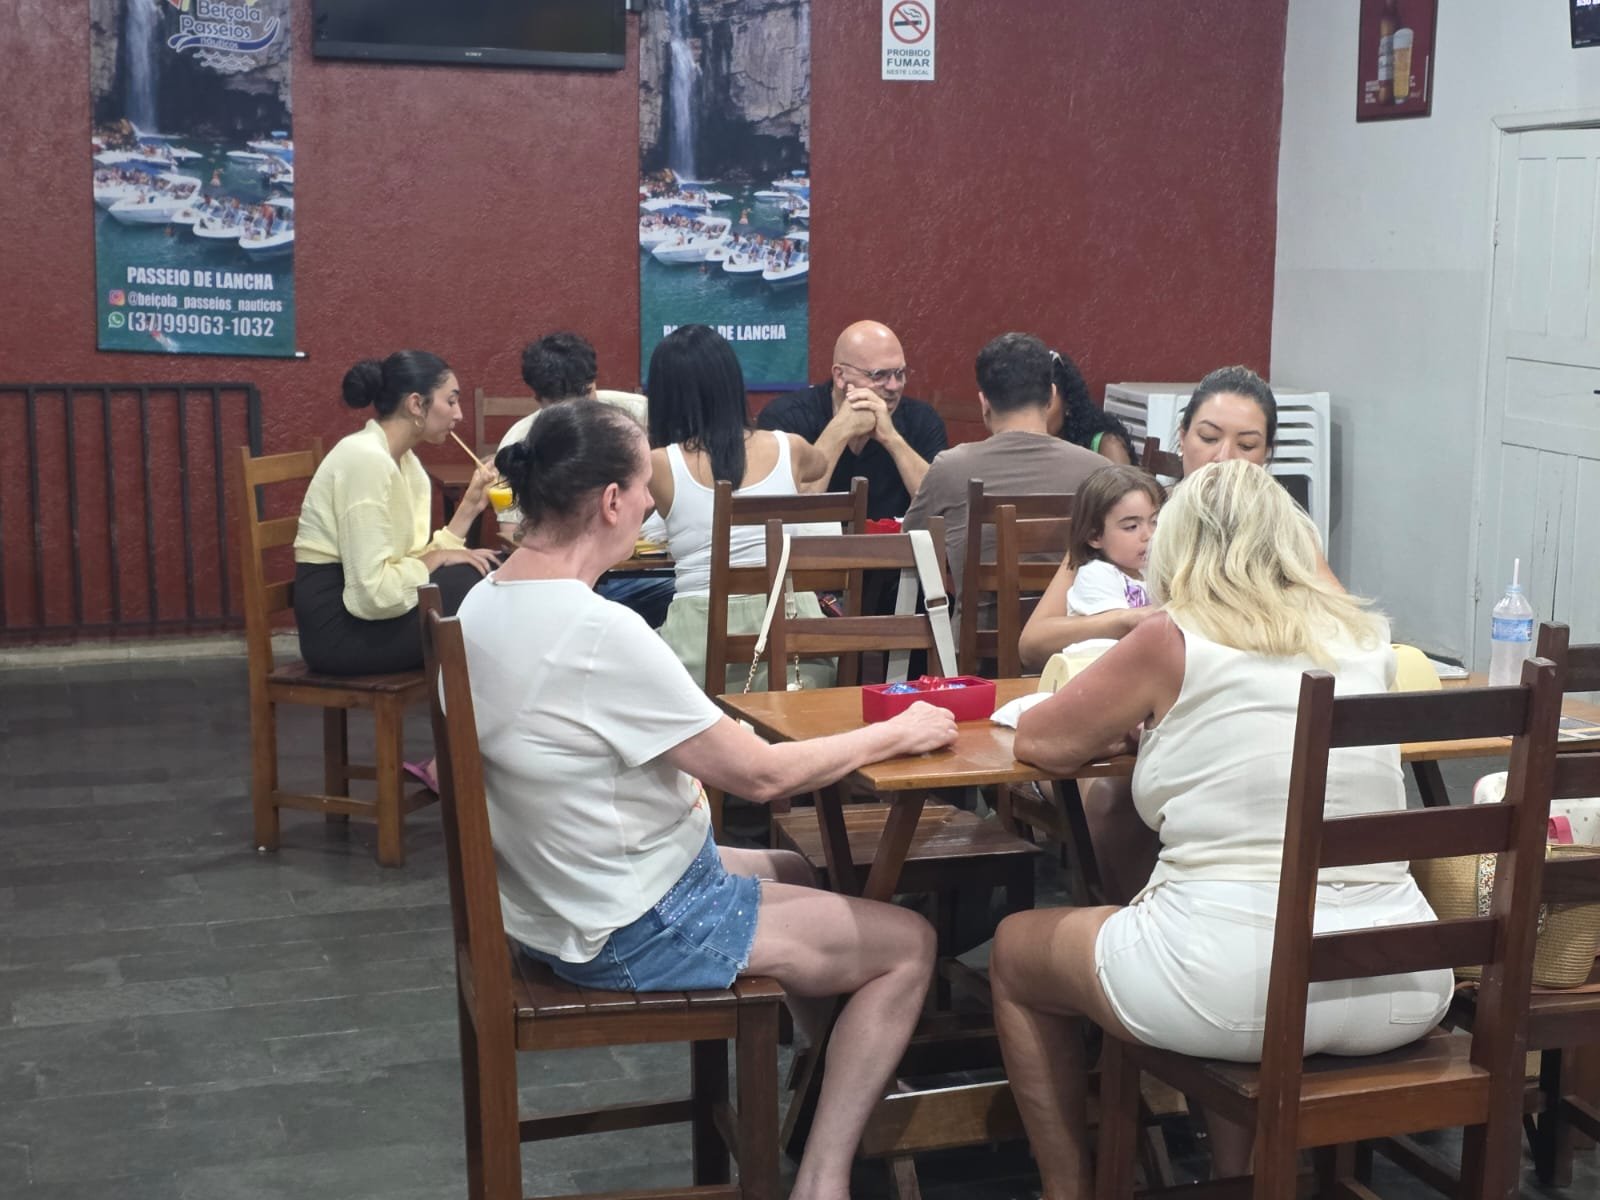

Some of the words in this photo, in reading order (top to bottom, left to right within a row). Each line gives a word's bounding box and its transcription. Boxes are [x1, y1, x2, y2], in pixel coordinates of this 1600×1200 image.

[198, 0, 261, 21] Beiçola
[181, 15, 251, 39] Passeios
[886, 48, 931, 57] PROIBIDO
[886, 58, 930, 68] FUMAR
[886, 68, 907, 76] NESTE
[127, 266, 190, 287] PASSEIO
[193, 270, 212, 289] DE
[215, 272, 274, 291] LANCHA
[127, 311, 275, 338] (37)99963-1032
[717, 325, 735, 341] DE
[736, 324, 787, 341] LANCHA
